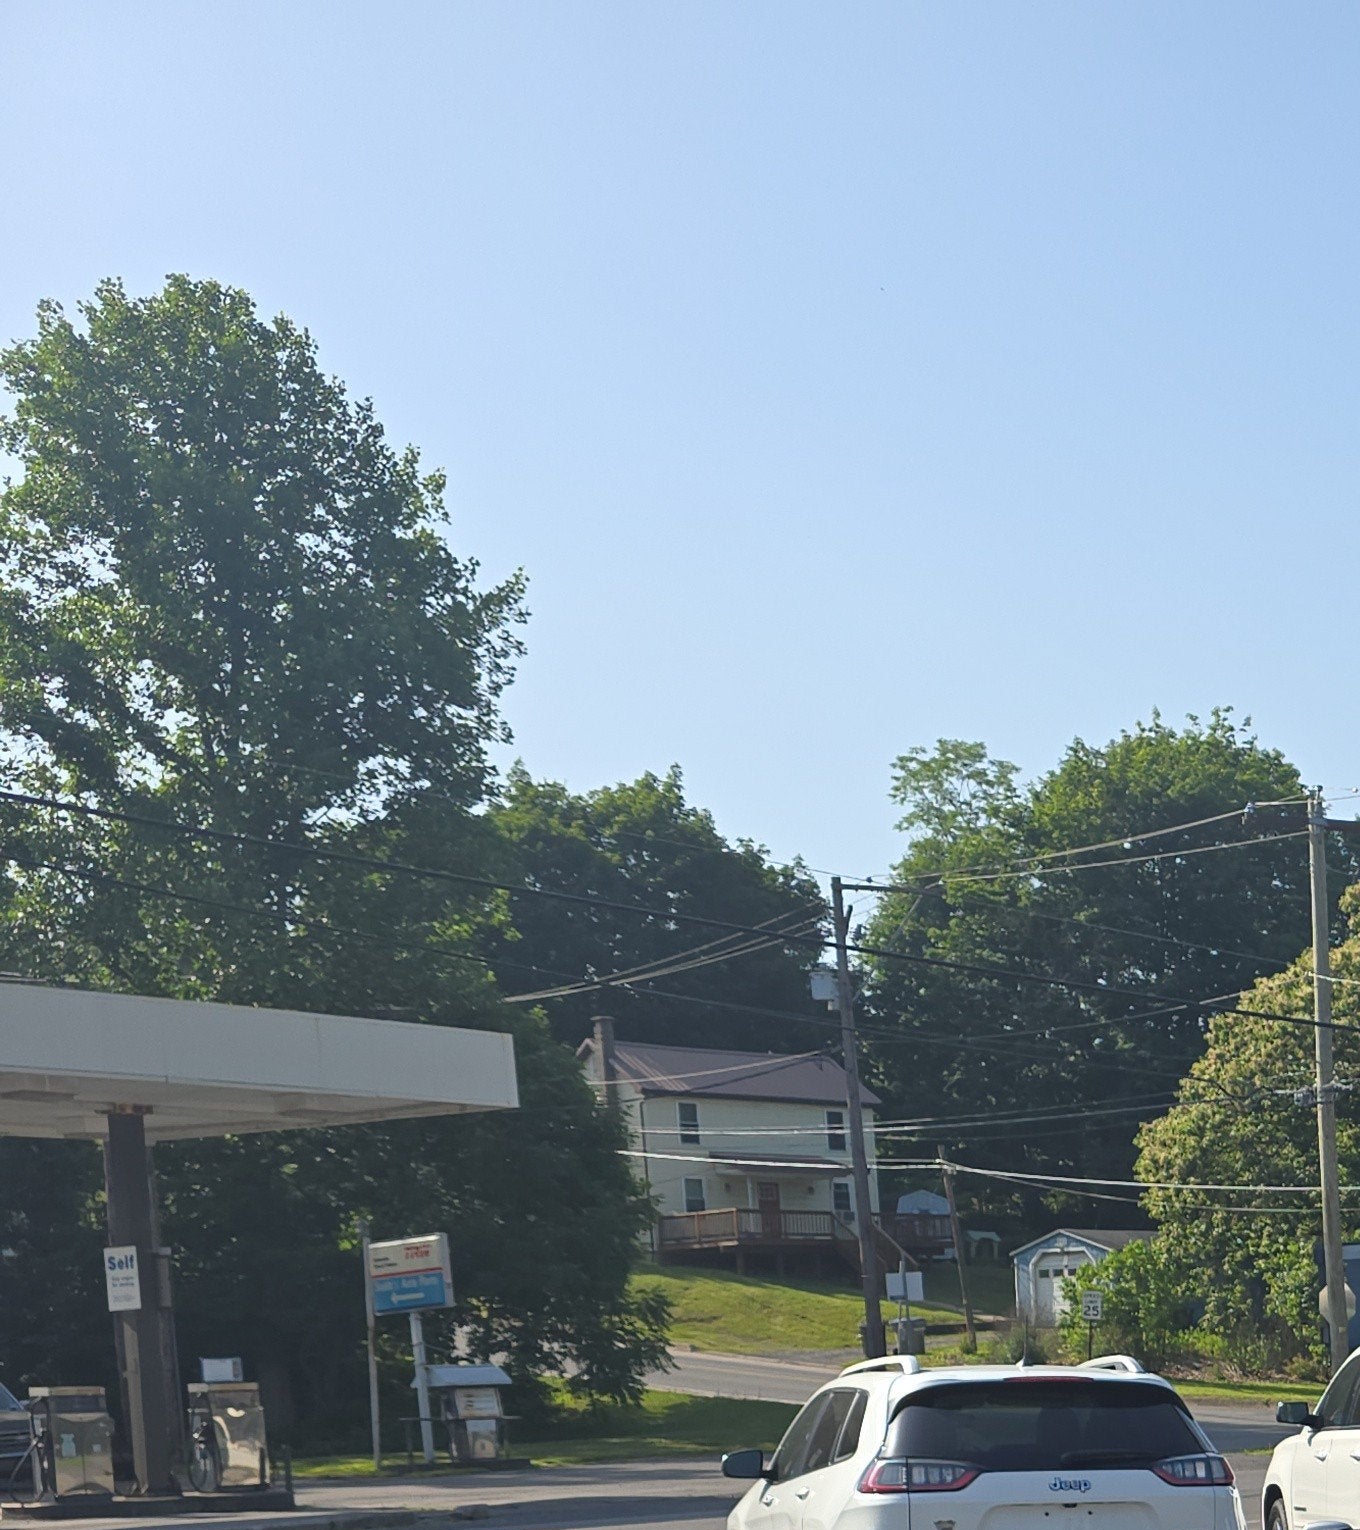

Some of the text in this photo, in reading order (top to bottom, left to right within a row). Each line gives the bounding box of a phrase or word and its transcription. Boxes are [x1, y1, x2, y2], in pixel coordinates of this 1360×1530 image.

[108, 1254, 134, 1270] Self
[1083, 1305, 1099, 1317] 25
[1049, 1477, 1091, 1493] Jeep
